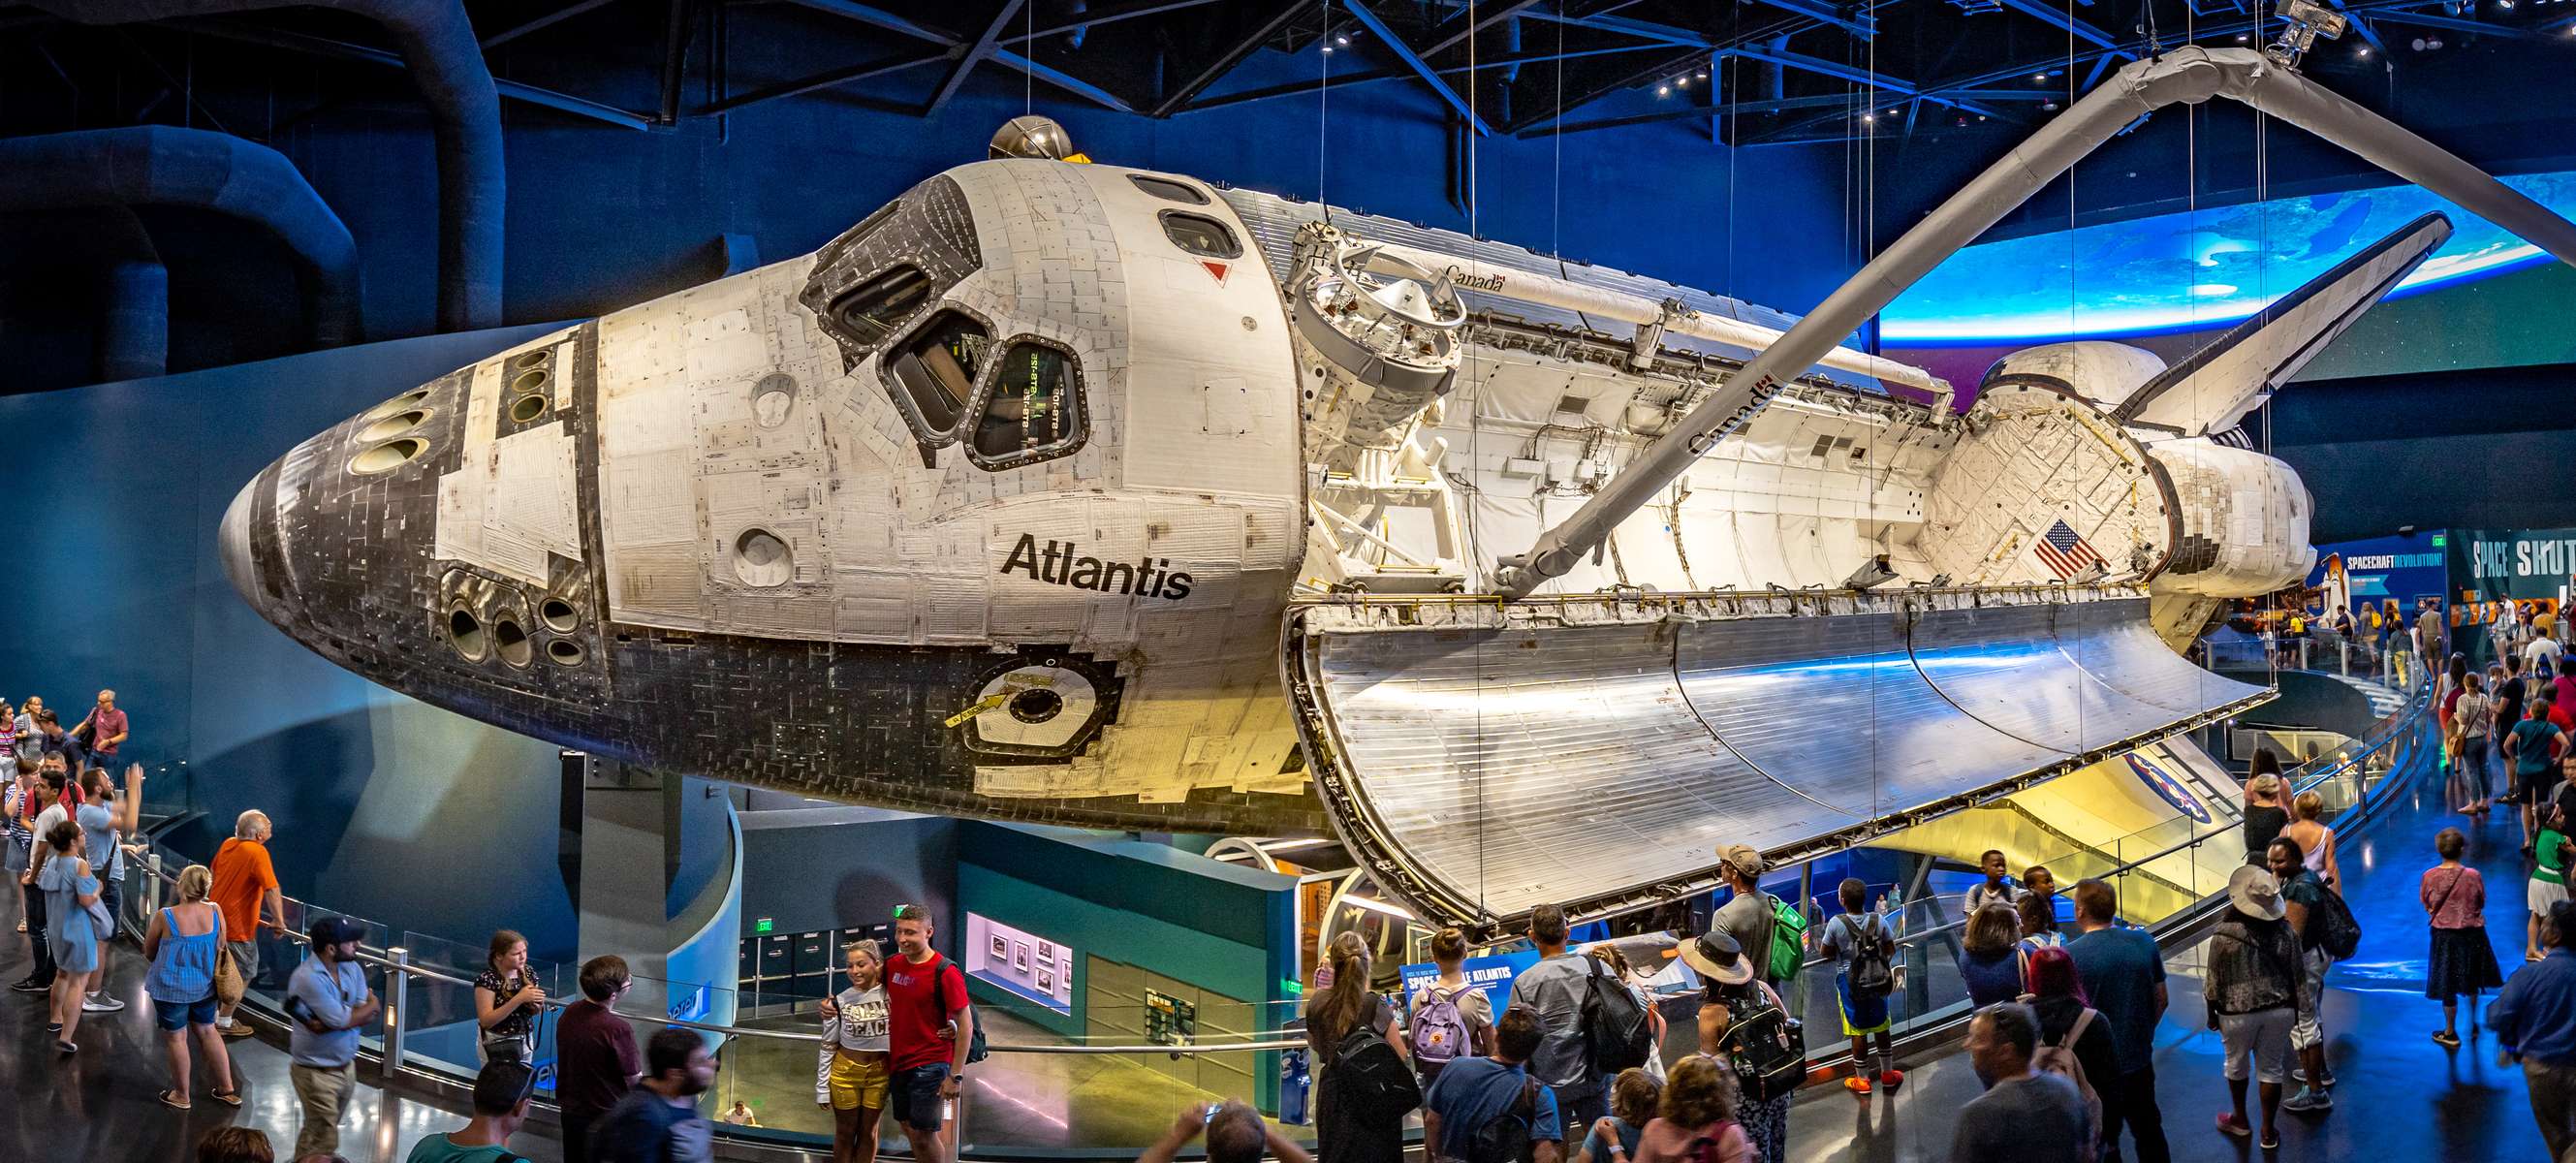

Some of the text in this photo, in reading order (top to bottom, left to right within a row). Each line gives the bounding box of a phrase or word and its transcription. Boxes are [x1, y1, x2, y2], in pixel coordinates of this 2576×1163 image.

[1446, 265, 1504, 292] Canada
[1688, 383, 1783, 455] Canada
[1000, 533, 1193, 600] Atlantis
[2473, 541, 2508, 579] SPACE
[1408, 975, 1435, 990] SPACE
[1472, 967, 1512, 984] ATLANTIS
